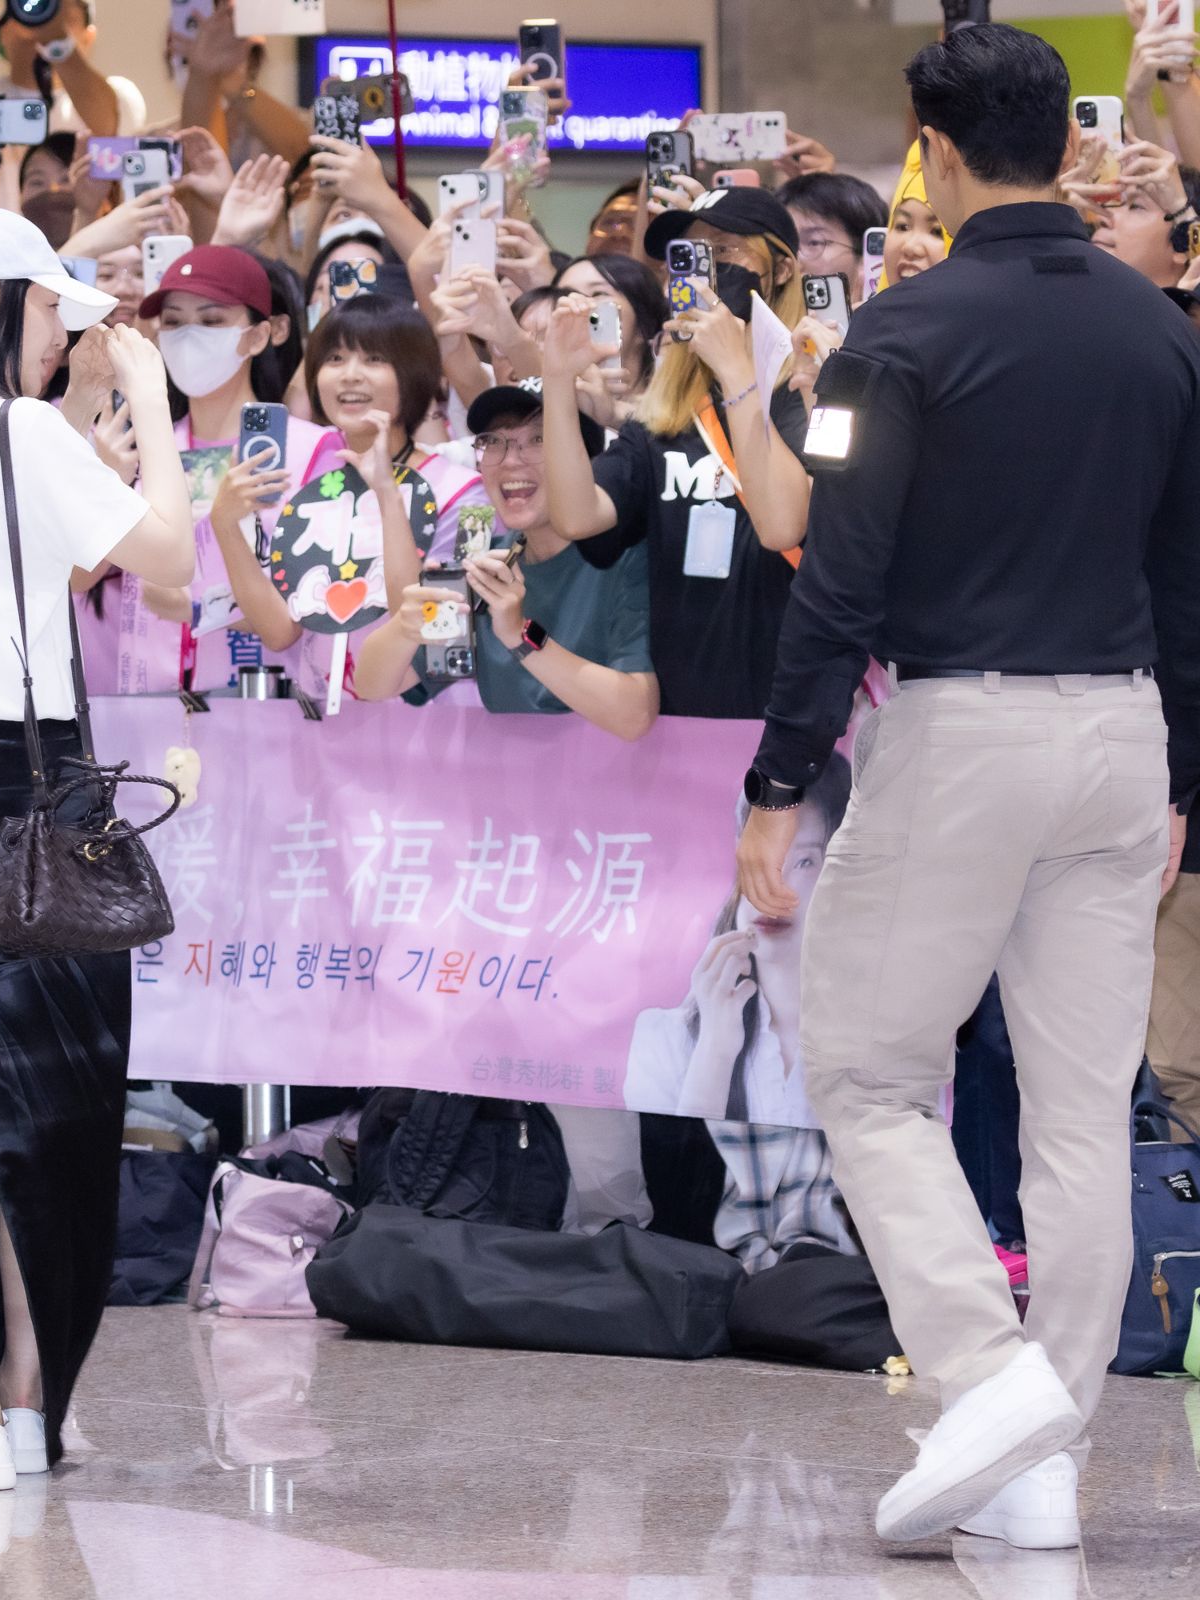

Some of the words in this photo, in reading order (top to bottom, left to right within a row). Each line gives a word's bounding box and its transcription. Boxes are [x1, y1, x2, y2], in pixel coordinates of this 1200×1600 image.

[183, 938, 277, 989] 지혜와
[295, 941, 384, 991] 행복의
[397, 946, 559, 1001] 기원이다.
